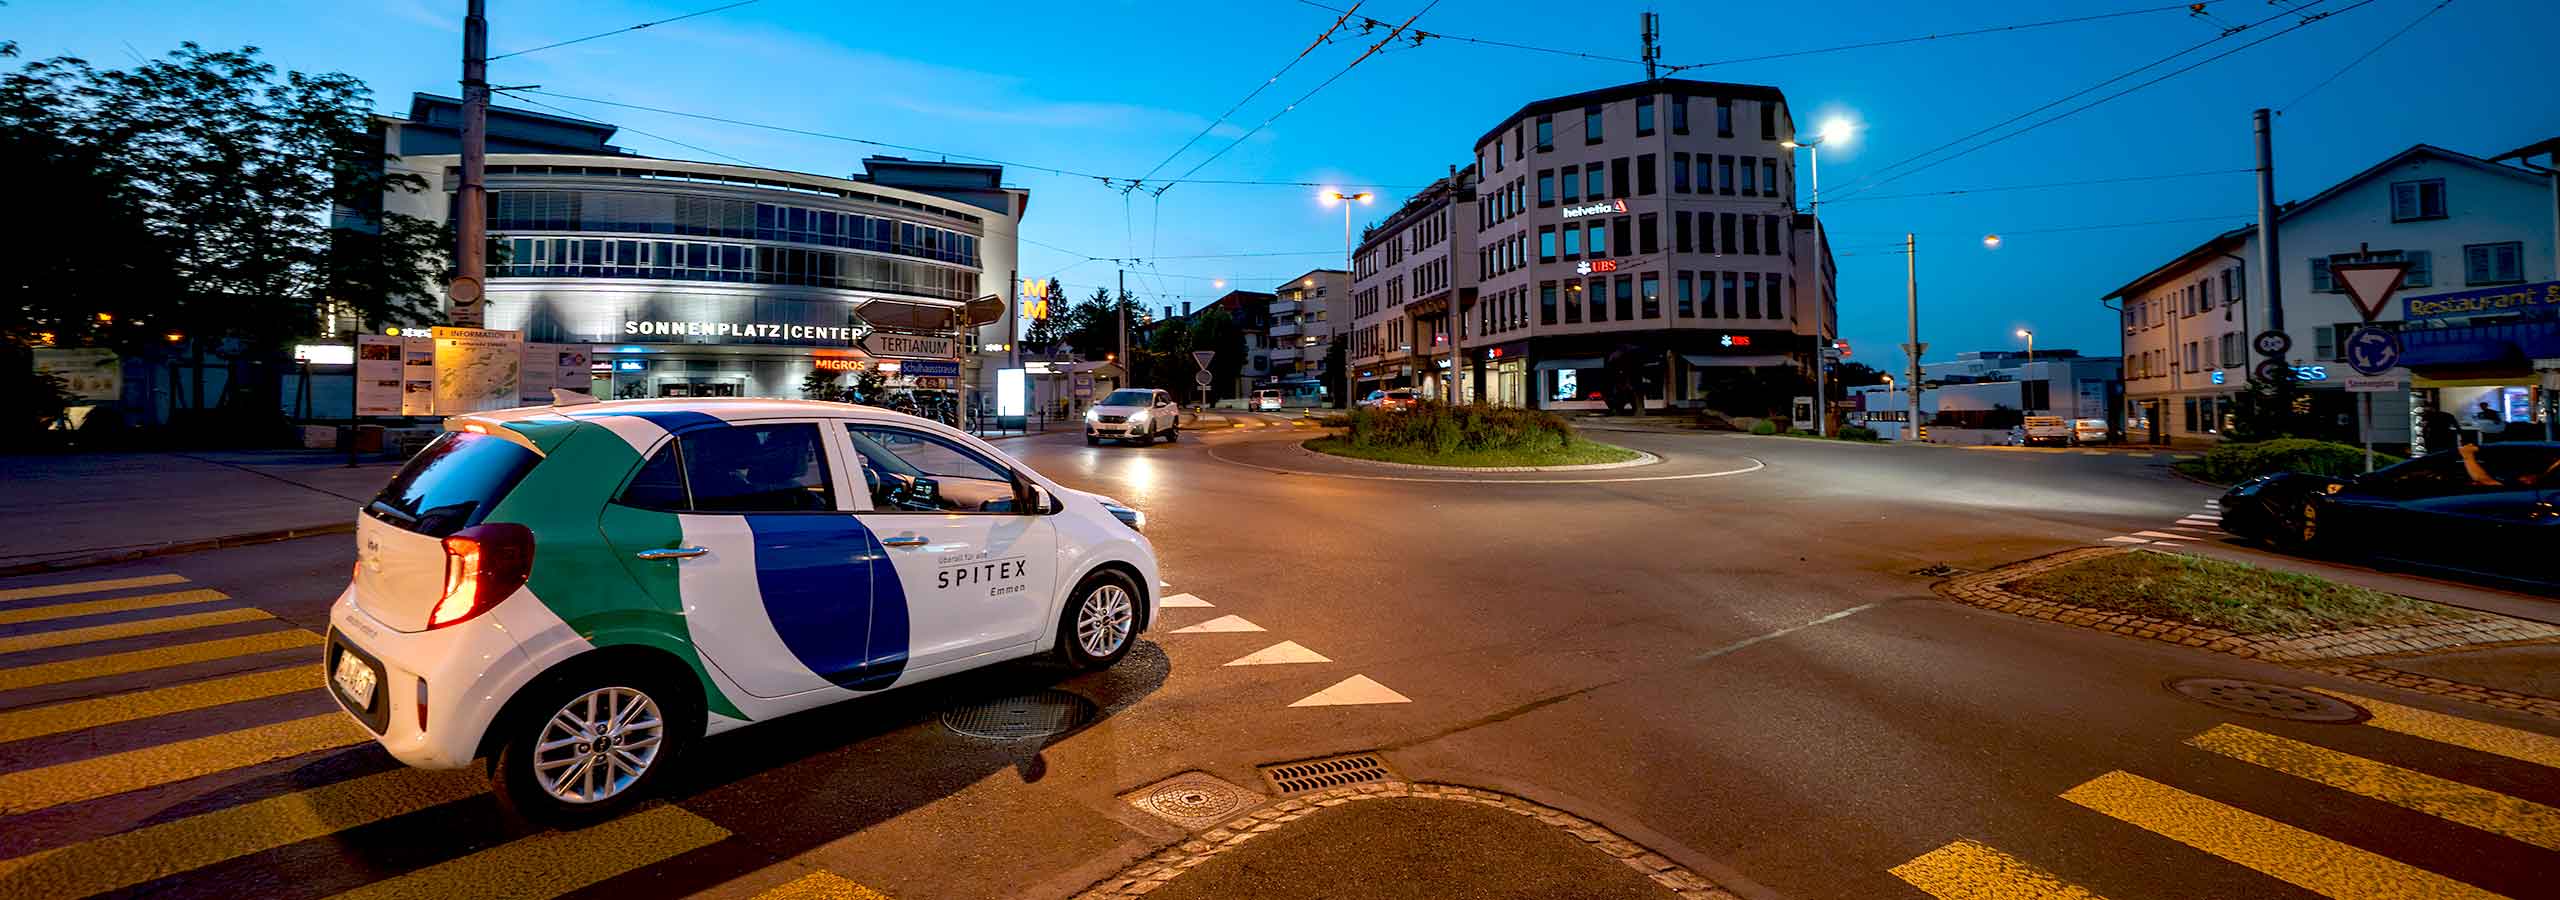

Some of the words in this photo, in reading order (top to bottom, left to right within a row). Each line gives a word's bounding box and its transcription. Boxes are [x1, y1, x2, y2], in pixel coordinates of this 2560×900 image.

[1563, 203, 1612, 218] helvetia
[1592, 260, 1617, 273] UBS
[2410, 288, 2538, 316] Restaurant
[880, 336, 948, 354] TERTIANUM
[815, 359, 865, 371] MIGROS
[937, 560, 1026, 589] SPITEX
[990, 584, 1026, 597] Emmen
